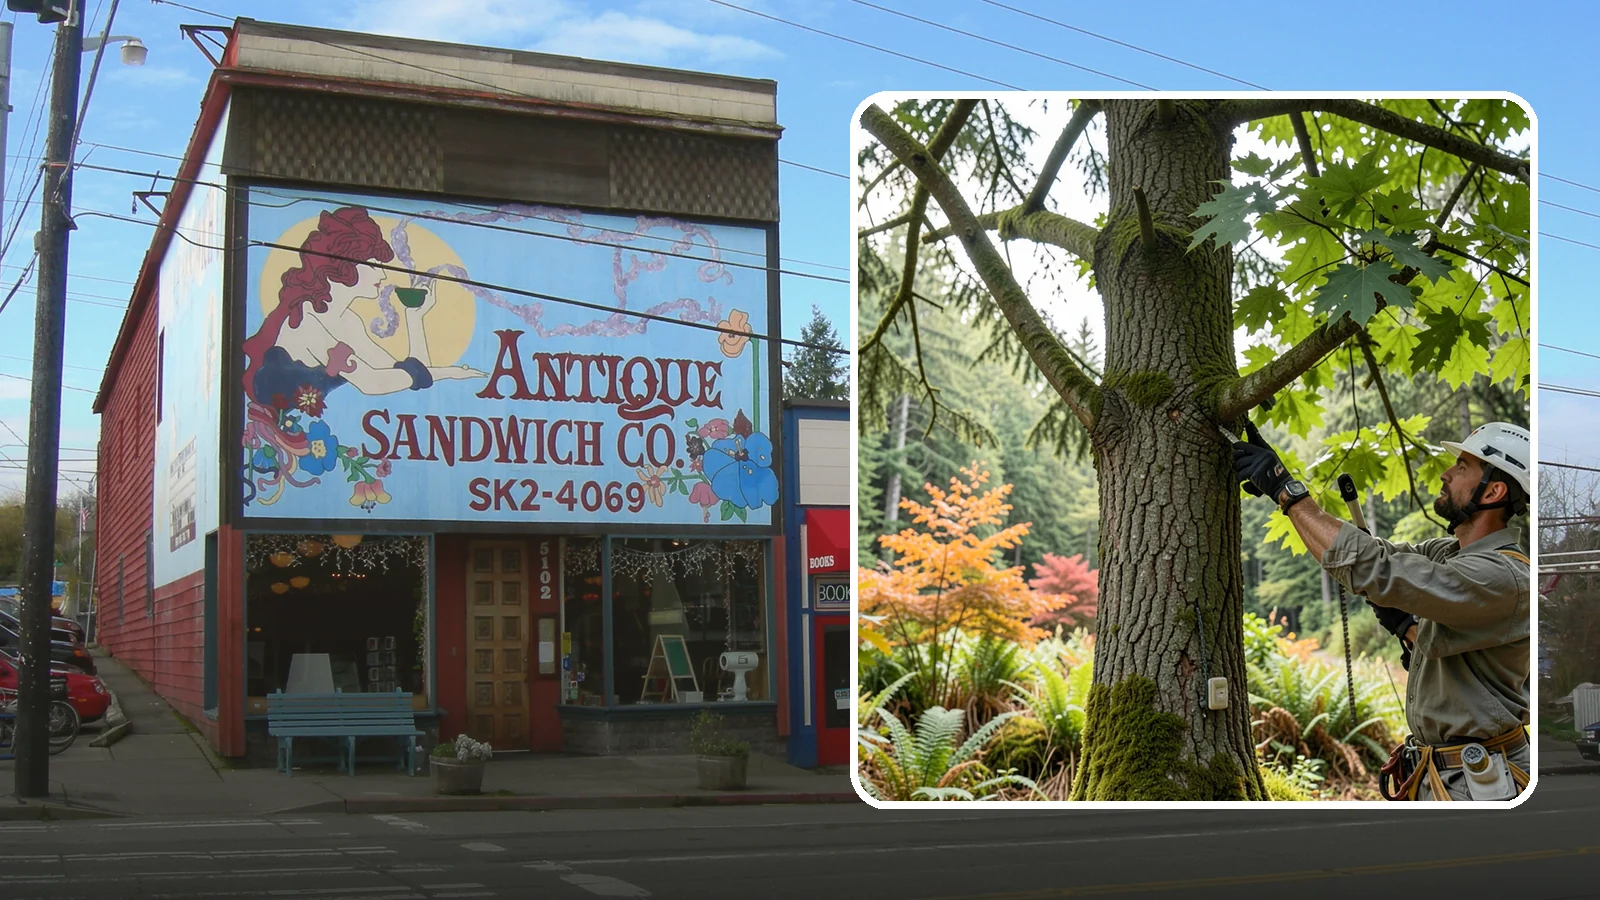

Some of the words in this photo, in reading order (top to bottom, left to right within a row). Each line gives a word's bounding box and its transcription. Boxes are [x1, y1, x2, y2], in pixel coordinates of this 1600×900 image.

[475, 329, 723, 421] ANTIQUE
[361, 408, 604, 467] SANDWICH
[617, 422, 685, 468] CO.
[468, 477, 646, 513] SK2-4069
[539, 542, 551, 599] 5102
[809, 555, 835, 569] BOOKS
